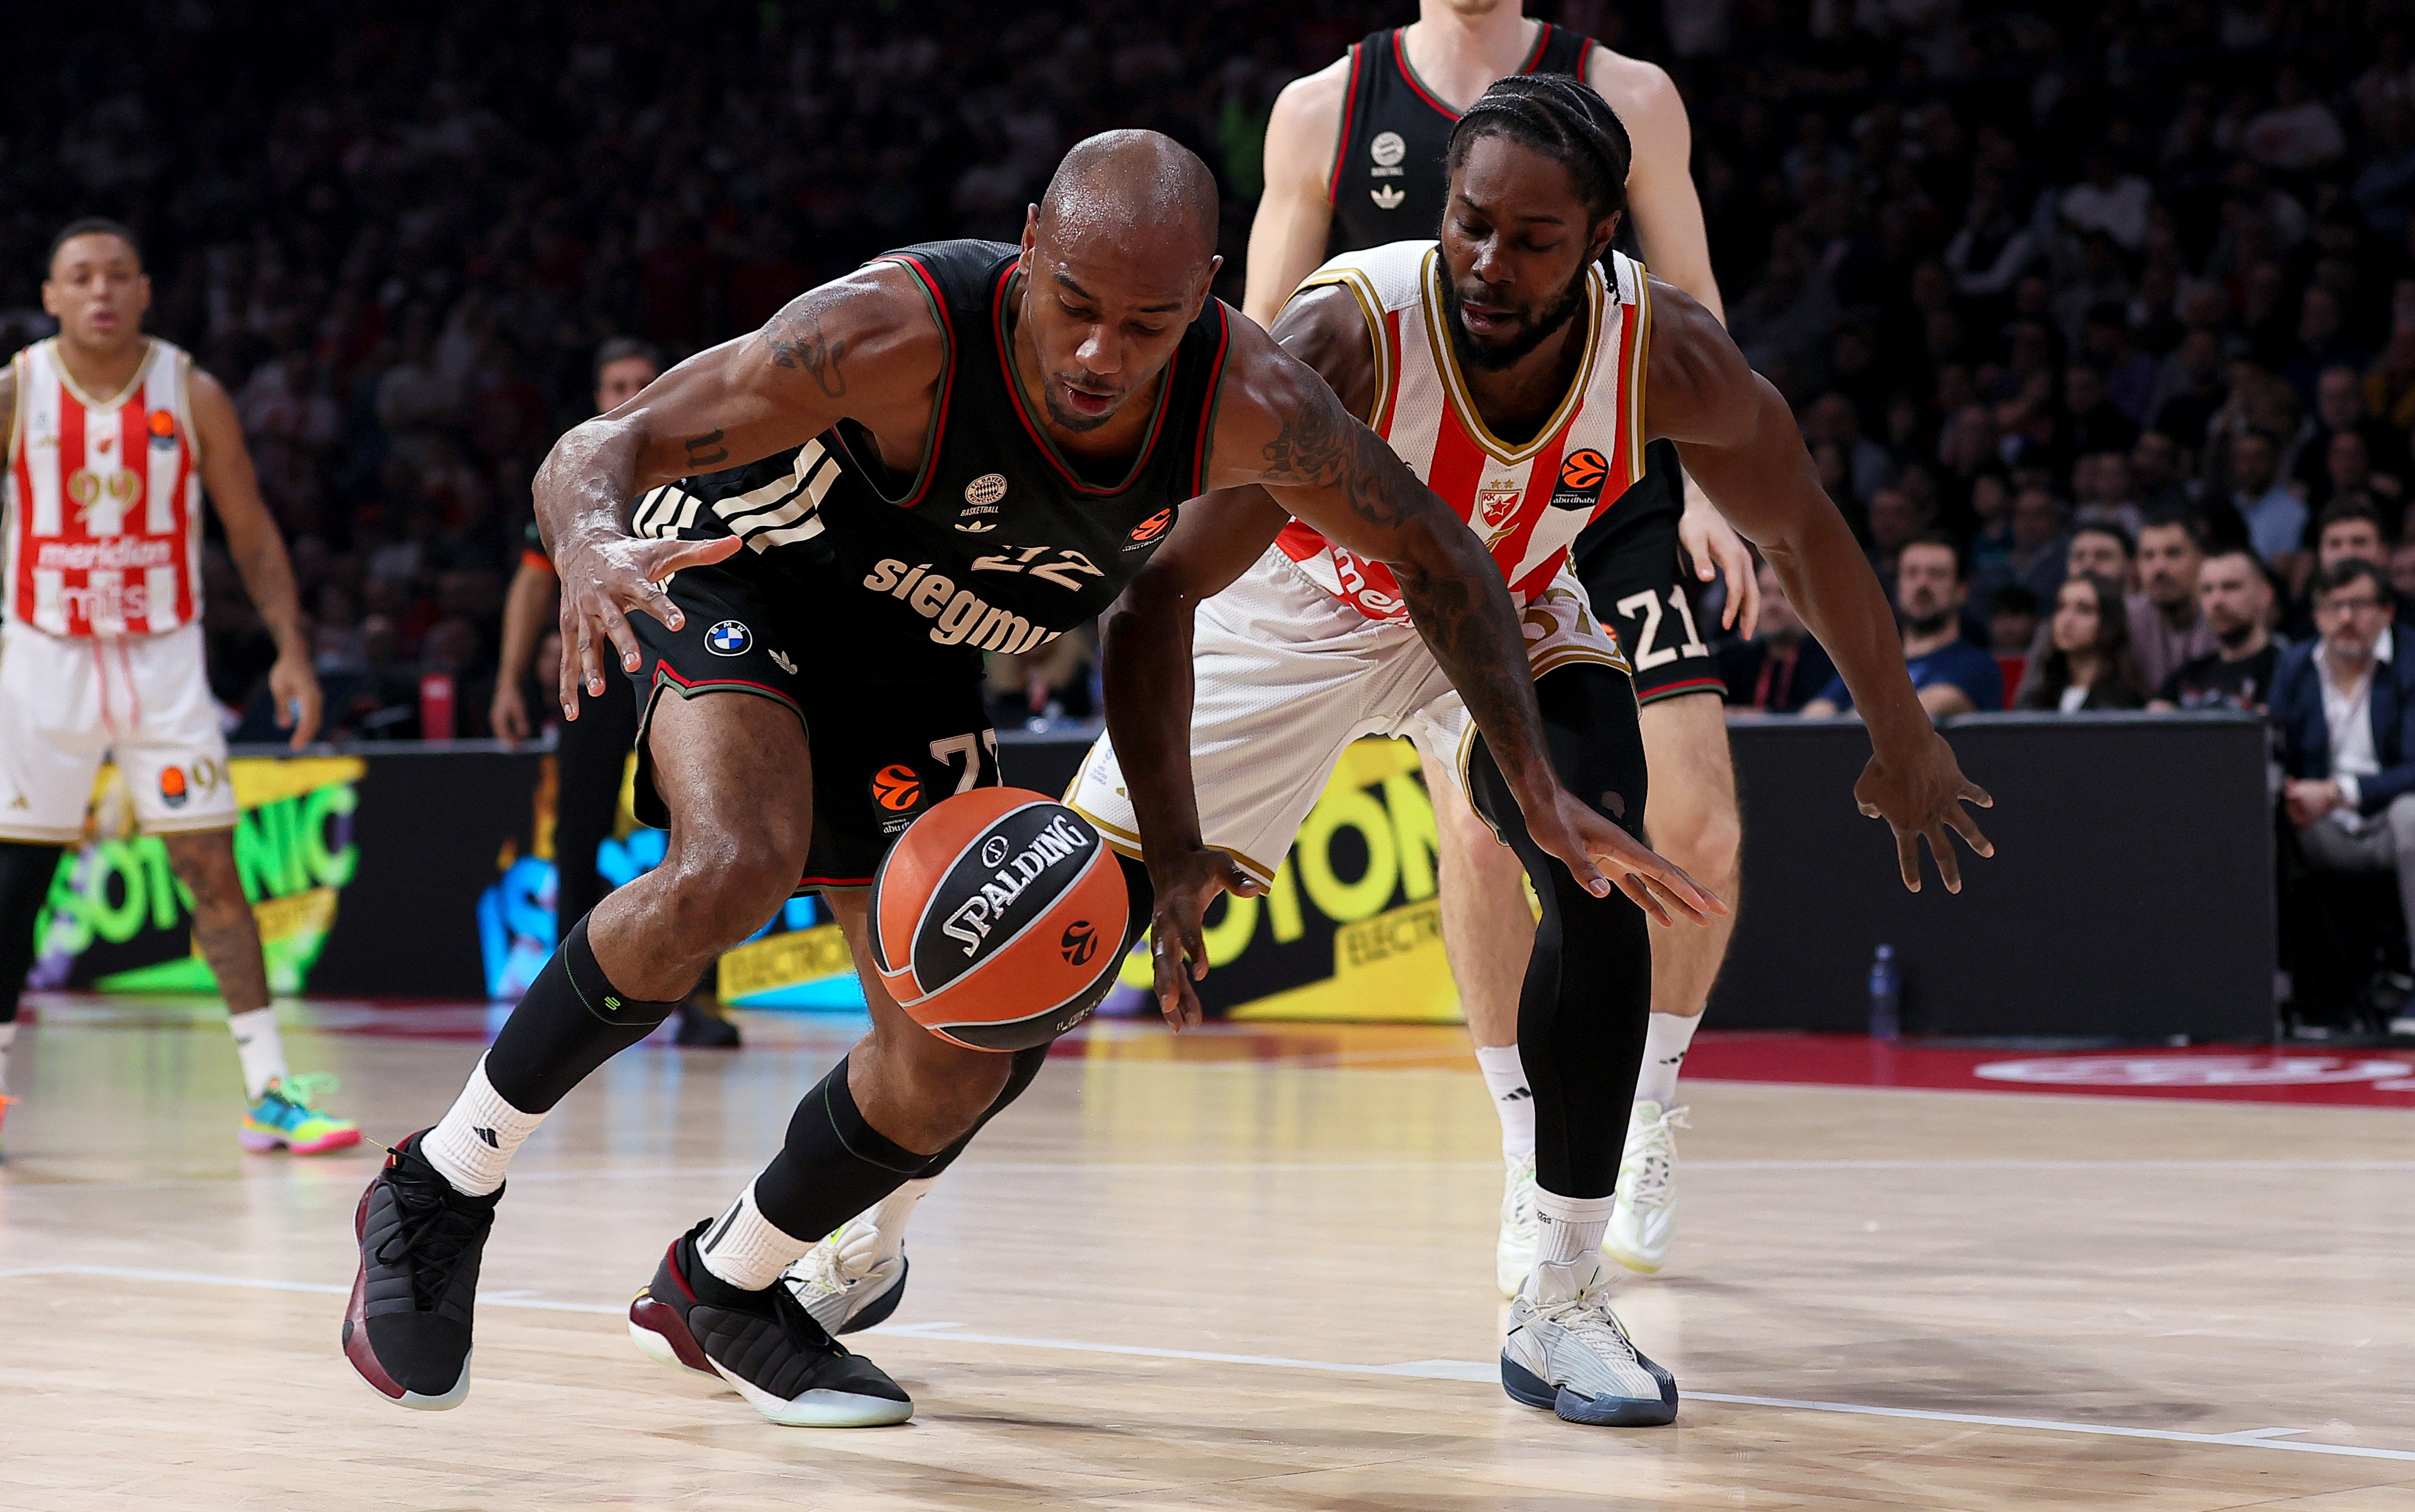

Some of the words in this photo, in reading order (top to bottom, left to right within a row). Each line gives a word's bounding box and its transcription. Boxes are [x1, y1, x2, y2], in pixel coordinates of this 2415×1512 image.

[981, 476, 1004, 488] BAYERN
[960, 506, 999, 516] BASKETBALL
[37, 536, 172, 570] meridian
[711, 622, 746, 635] BMW
[1616, 584, 1710, 672] 21
[942, 814, 1089, 957] SPALDING
